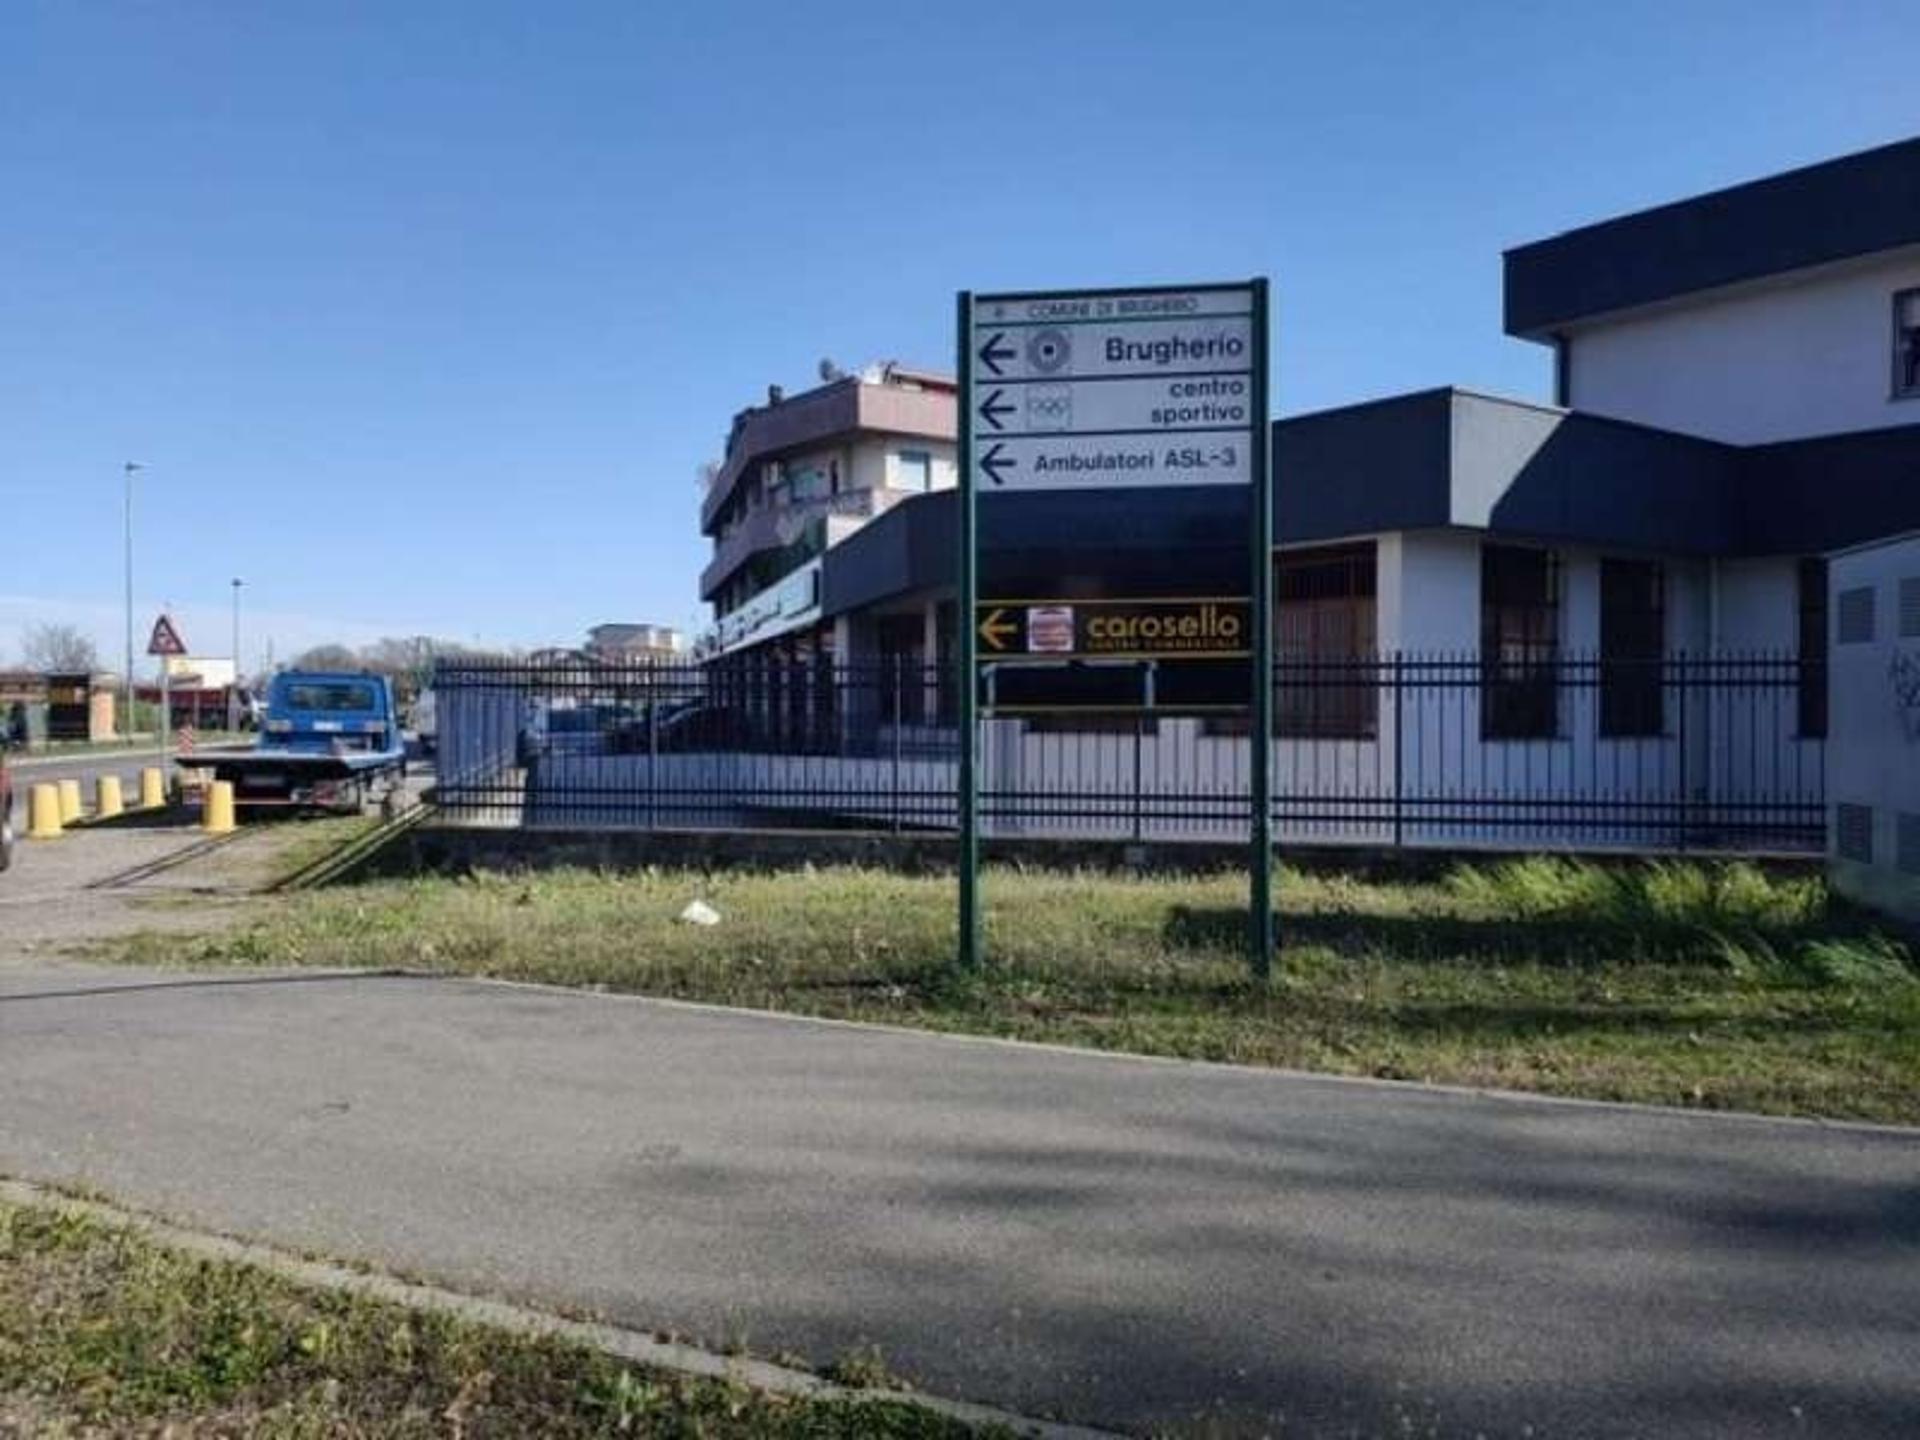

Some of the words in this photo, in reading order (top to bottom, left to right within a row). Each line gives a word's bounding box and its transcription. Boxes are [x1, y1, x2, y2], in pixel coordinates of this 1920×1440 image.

[1106, 334, 1243, 366] Brugherio
[1170, 378, 1244, 398] centro
[1152, 402, 1244, 426] sportivo
[1034, 449, 1153, 473] Ambulatori
[1165, 446, 1236, 468] ASL-3
[1087, 605, 1239, 637] carosello
